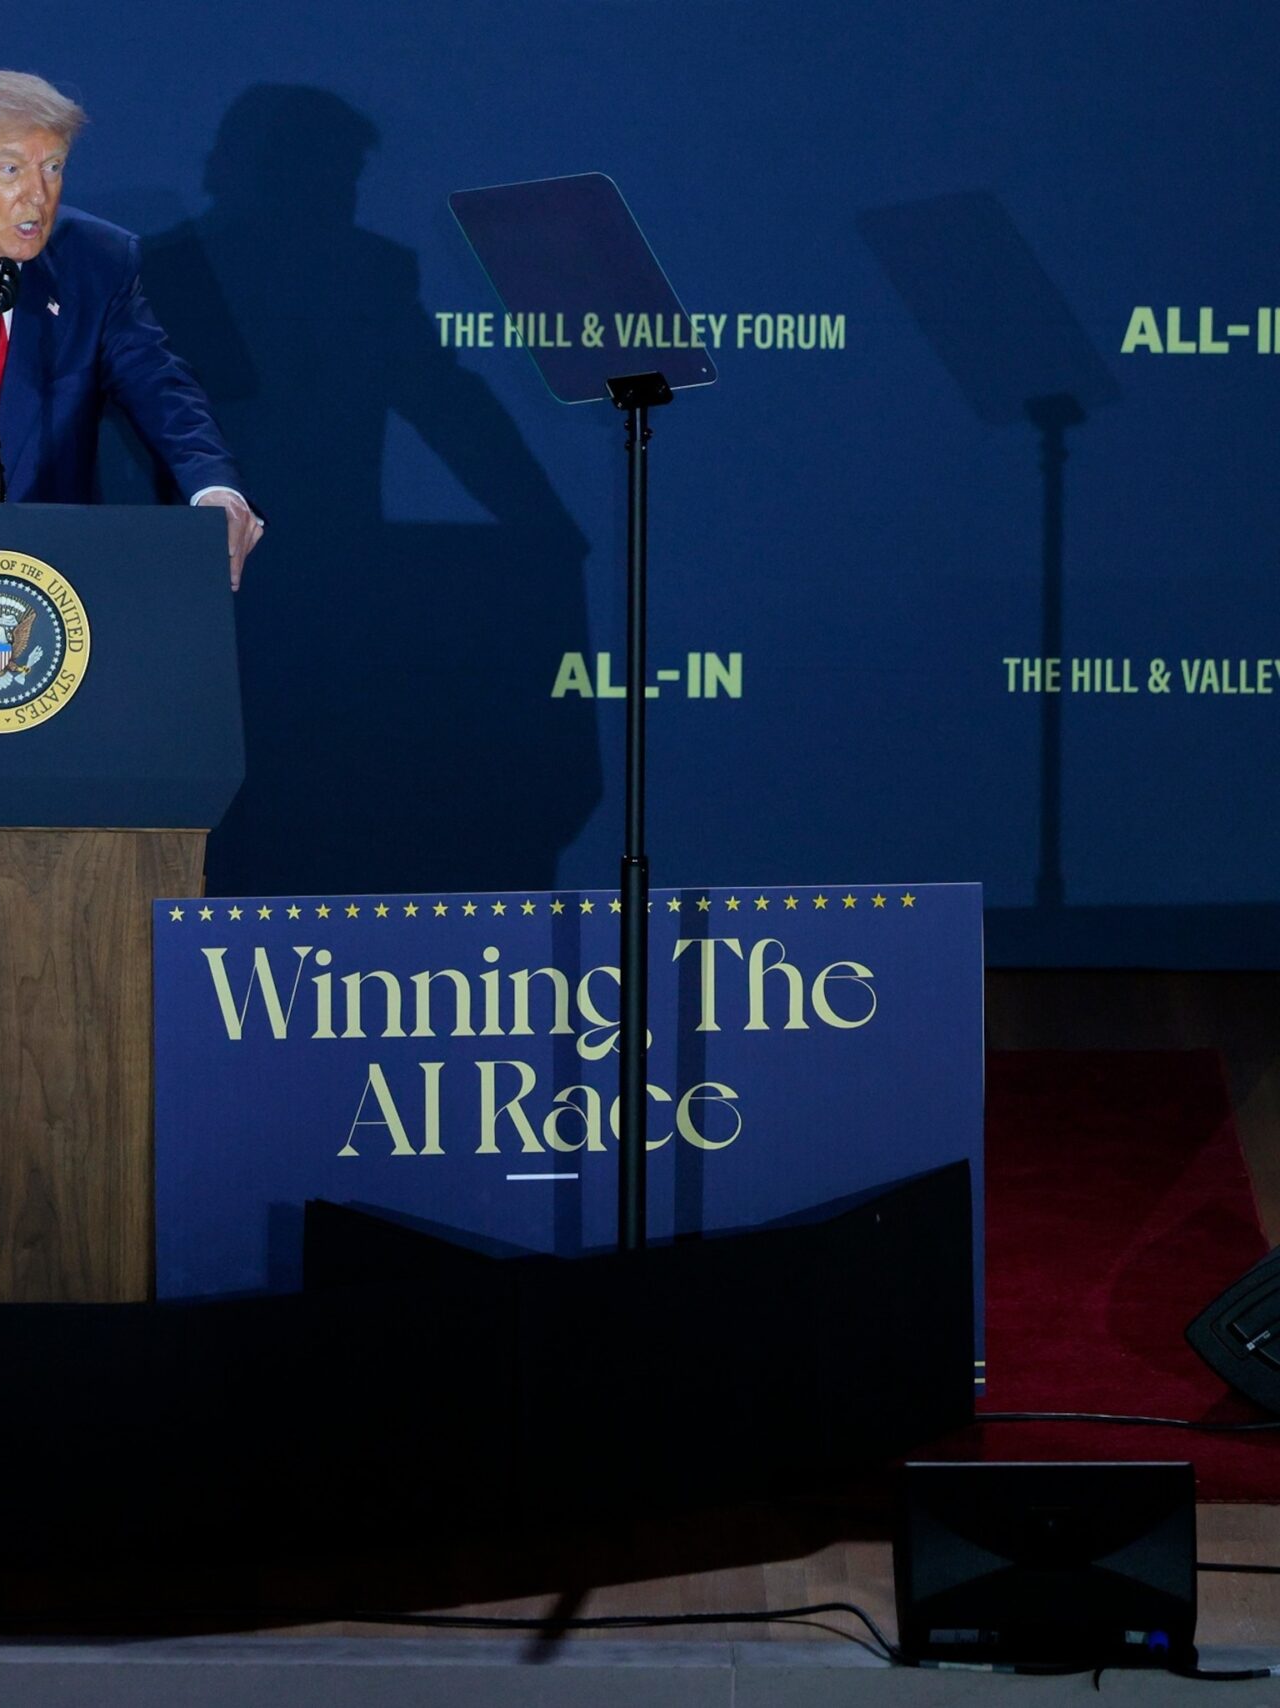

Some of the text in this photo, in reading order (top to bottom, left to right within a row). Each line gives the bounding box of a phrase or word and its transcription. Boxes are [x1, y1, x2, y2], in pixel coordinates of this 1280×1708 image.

[435, 312, 846, 350] THE HILL & VALLEY FORUM
[1120, 306, 1280, 354] ALL-I
[0, 559, 18, 571] OF
[21, 563, 43, 581] THE
[48, 579, 83, 653] UNITED
[14, 669, 76, 724] STATES
[551, 652, 742, 699] AL-IN
[1003, 658, 1061, 692] THE
[1072, 658, 1139, 693] HILL
[1148, 658, 1172, 693] &
[201, 938, 878, 1061] Winning The
[337, 1061, 742, 1157] AI Race
